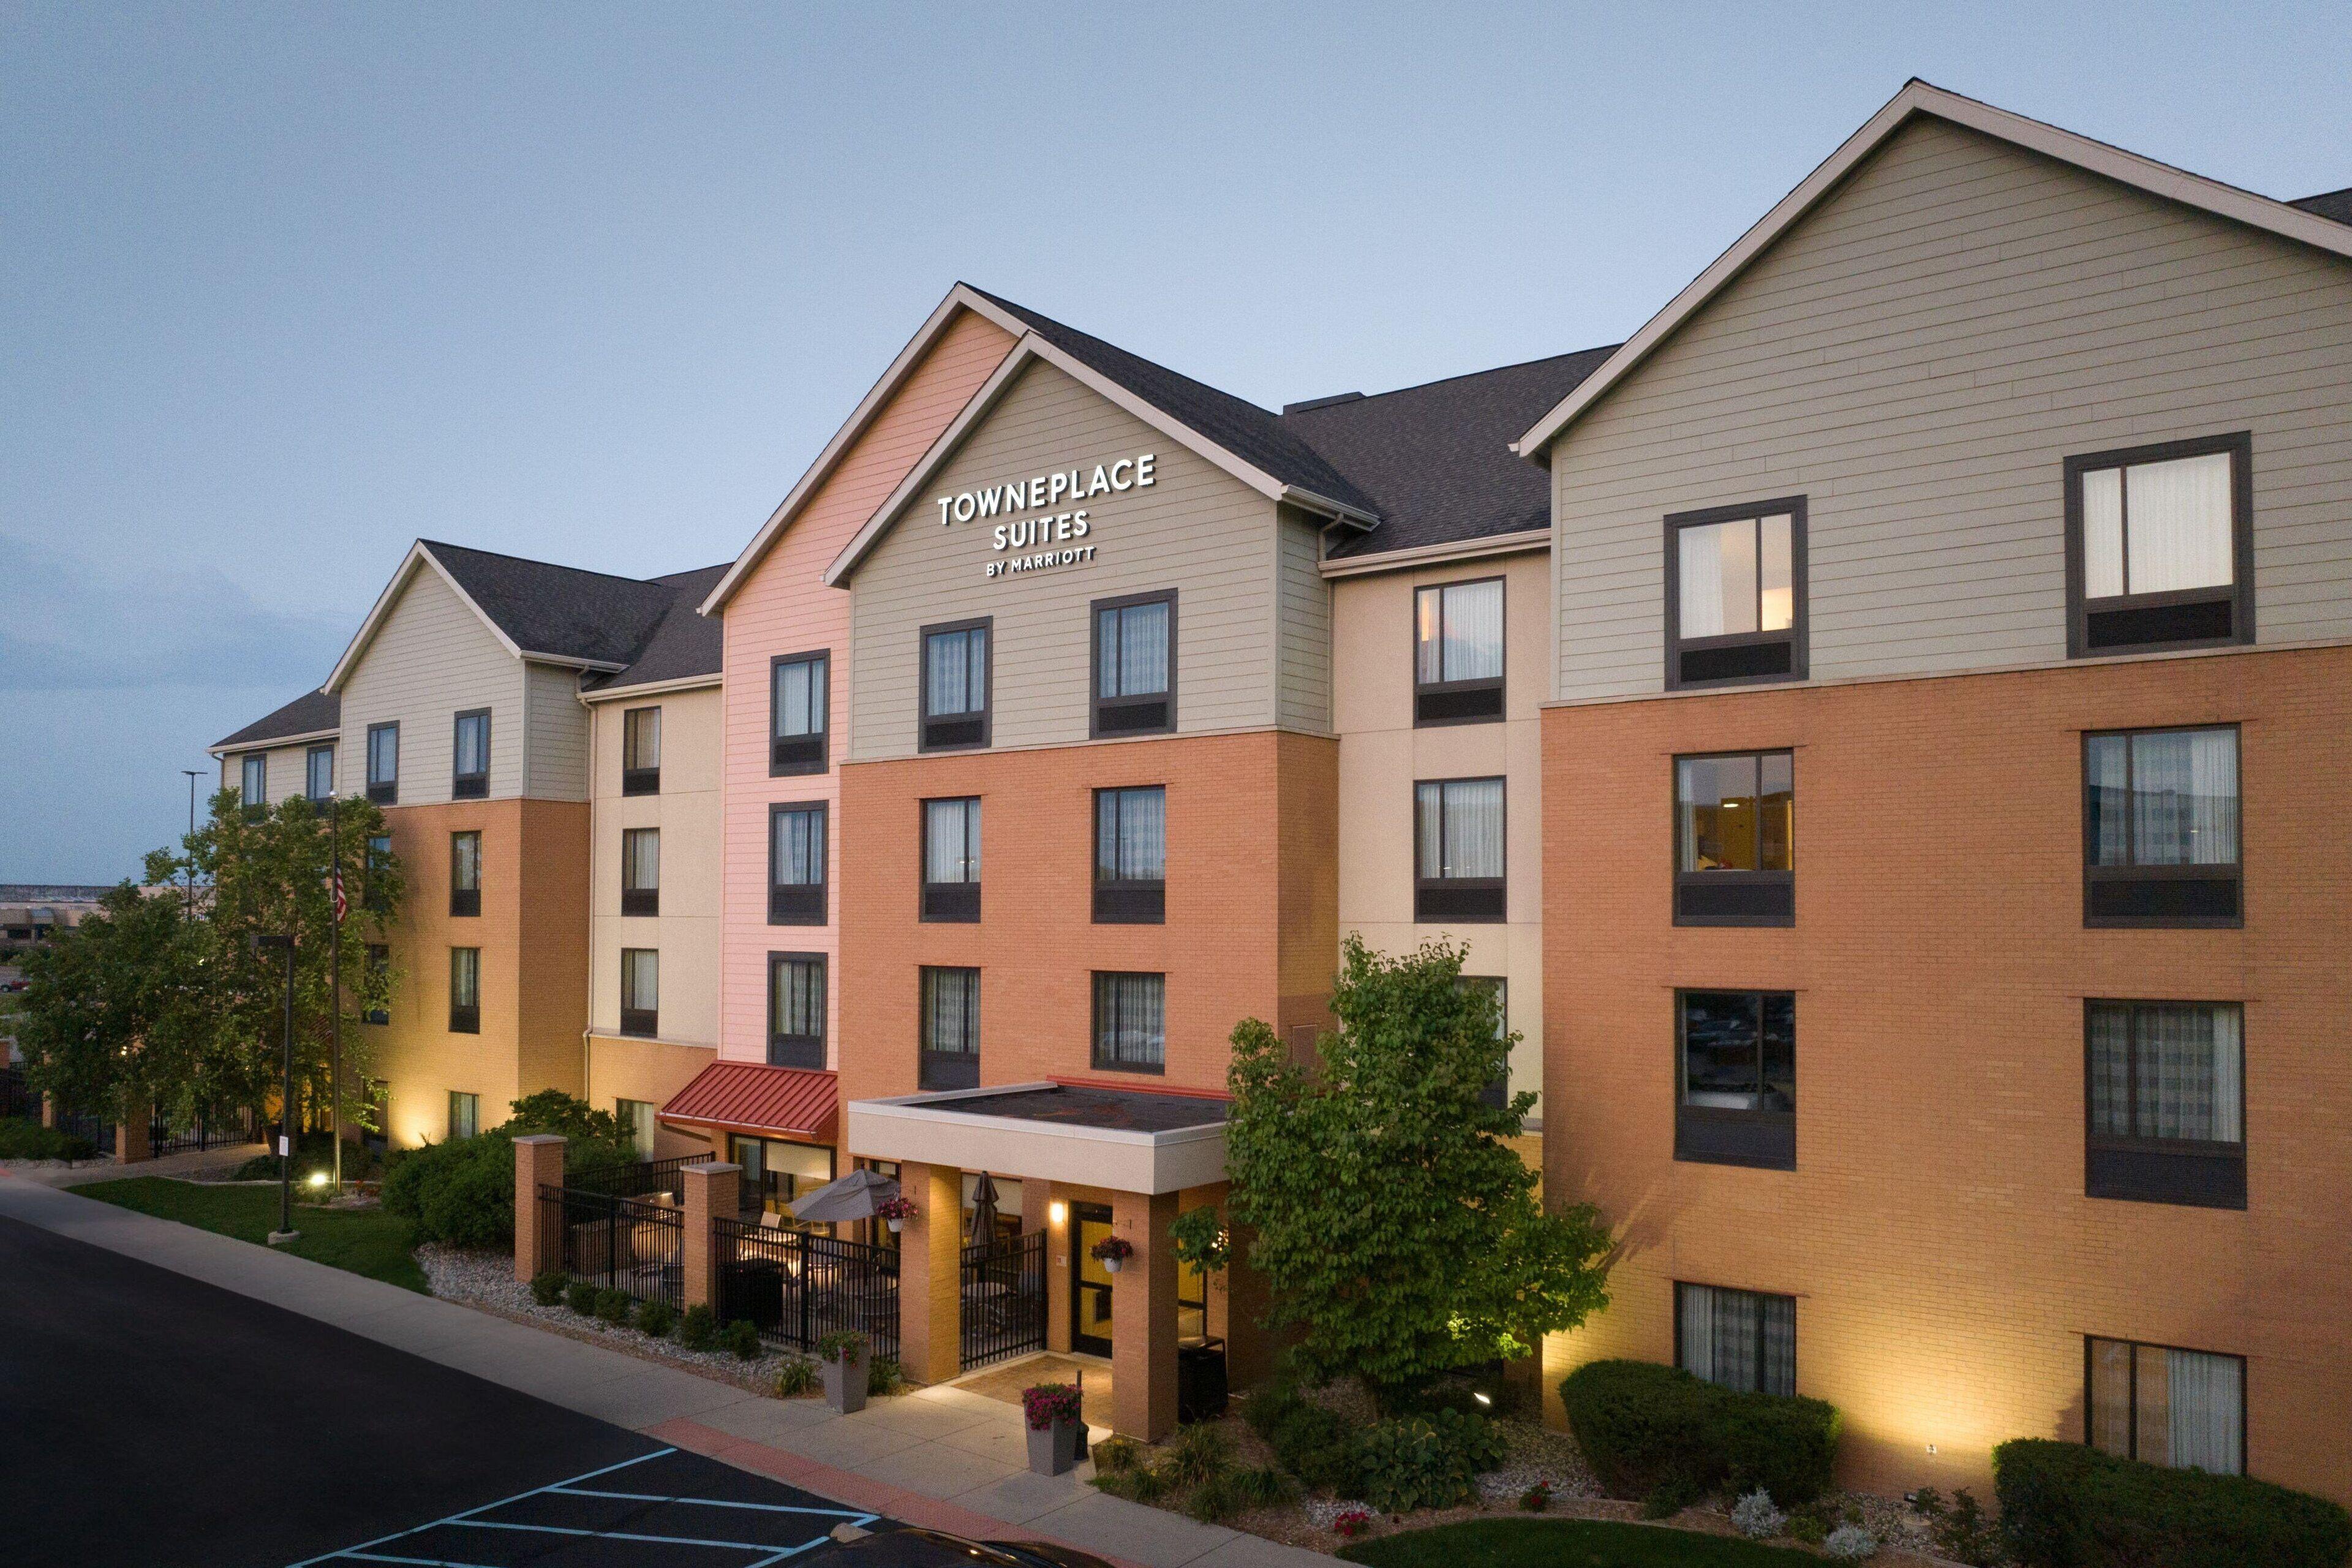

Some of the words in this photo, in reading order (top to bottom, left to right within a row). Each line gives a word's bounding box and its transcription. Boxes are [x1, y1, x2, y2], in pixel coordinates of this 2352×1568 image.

[938, 453, 1155, 525] TOWNEPLACE
[993, 510, 1089, 551] SUITES
[986, 560, 1006, 577] BY
[1011, 546, 1096, 572] MARRIOTT
